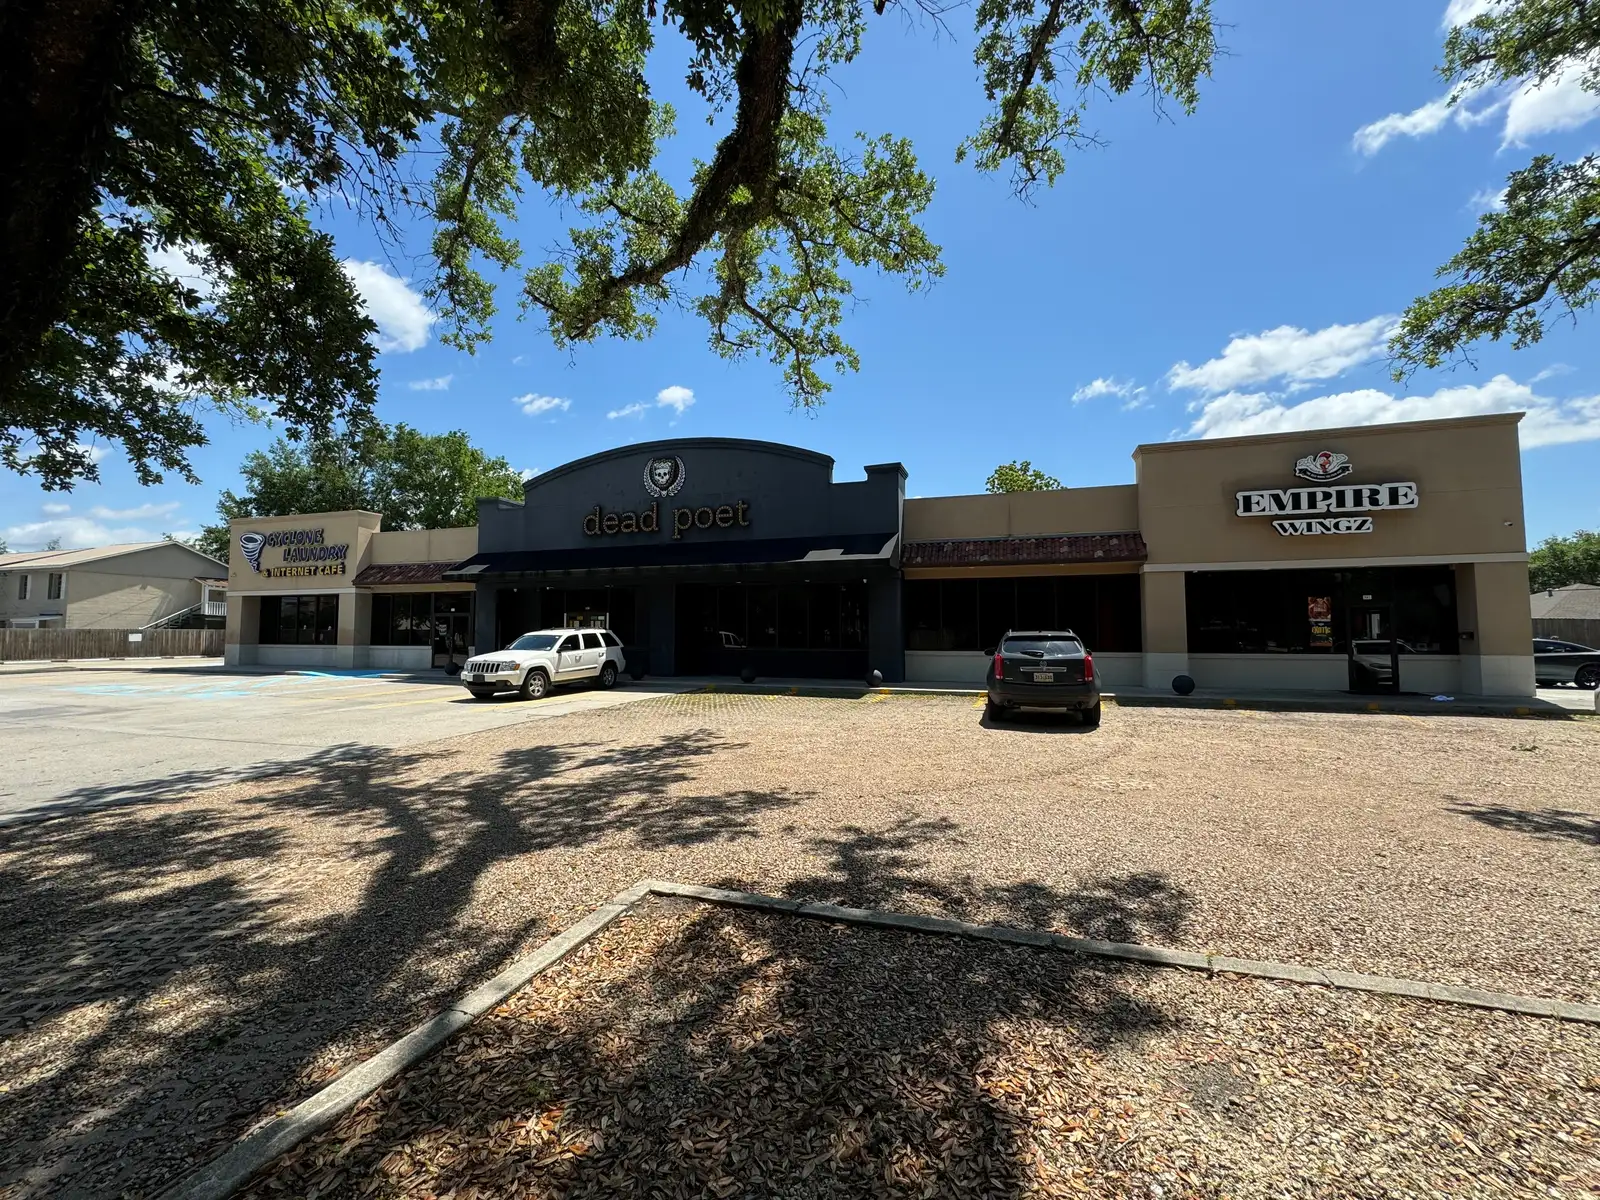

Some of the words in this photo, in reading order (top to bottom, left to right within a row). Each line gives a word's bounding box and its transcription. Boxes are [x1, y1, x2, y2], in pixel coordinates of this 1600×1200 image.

[1240, 485, 1415, 513] EMPIRE
[583, 502, 659, 535] dead
[672, 500, 749, 539] poet
[1275, 518, 1372, 534] WINGZ
[267, 529, 323, 546] CYCLONE
[283, 545, 348, 562] LAUNDRY
[261, 568, 268, 577] &
[271, 565, 316, 577] INTERNET
